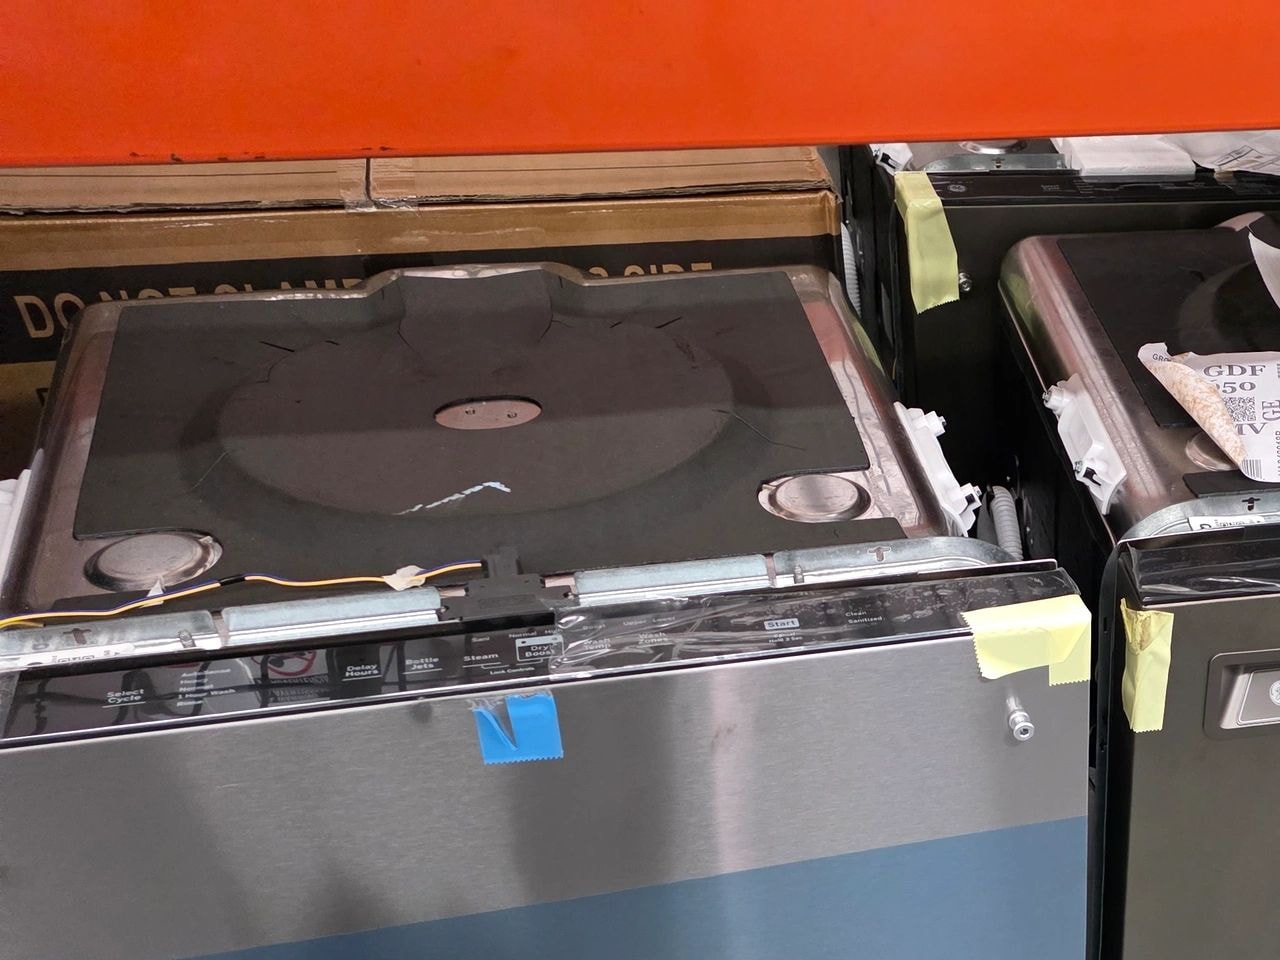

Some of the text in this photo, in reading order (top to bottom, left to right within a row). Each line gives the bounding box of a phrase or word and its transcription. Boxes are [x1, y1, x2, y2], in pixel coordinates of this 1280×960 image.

[1203, 364, 1266, 377] GDF
[767, 619, 796, 628] Start
[405, 657, 440, 666] Bottle
[463, 653, 499, 662] Steam
[347, 663, 378, 672] Delay
[411, 662, 434, 670] Jets
[345, 669, 379, 677] Hours
[106, 689, 144, 698] Select
[107, 694, 142, 704] Cycle
